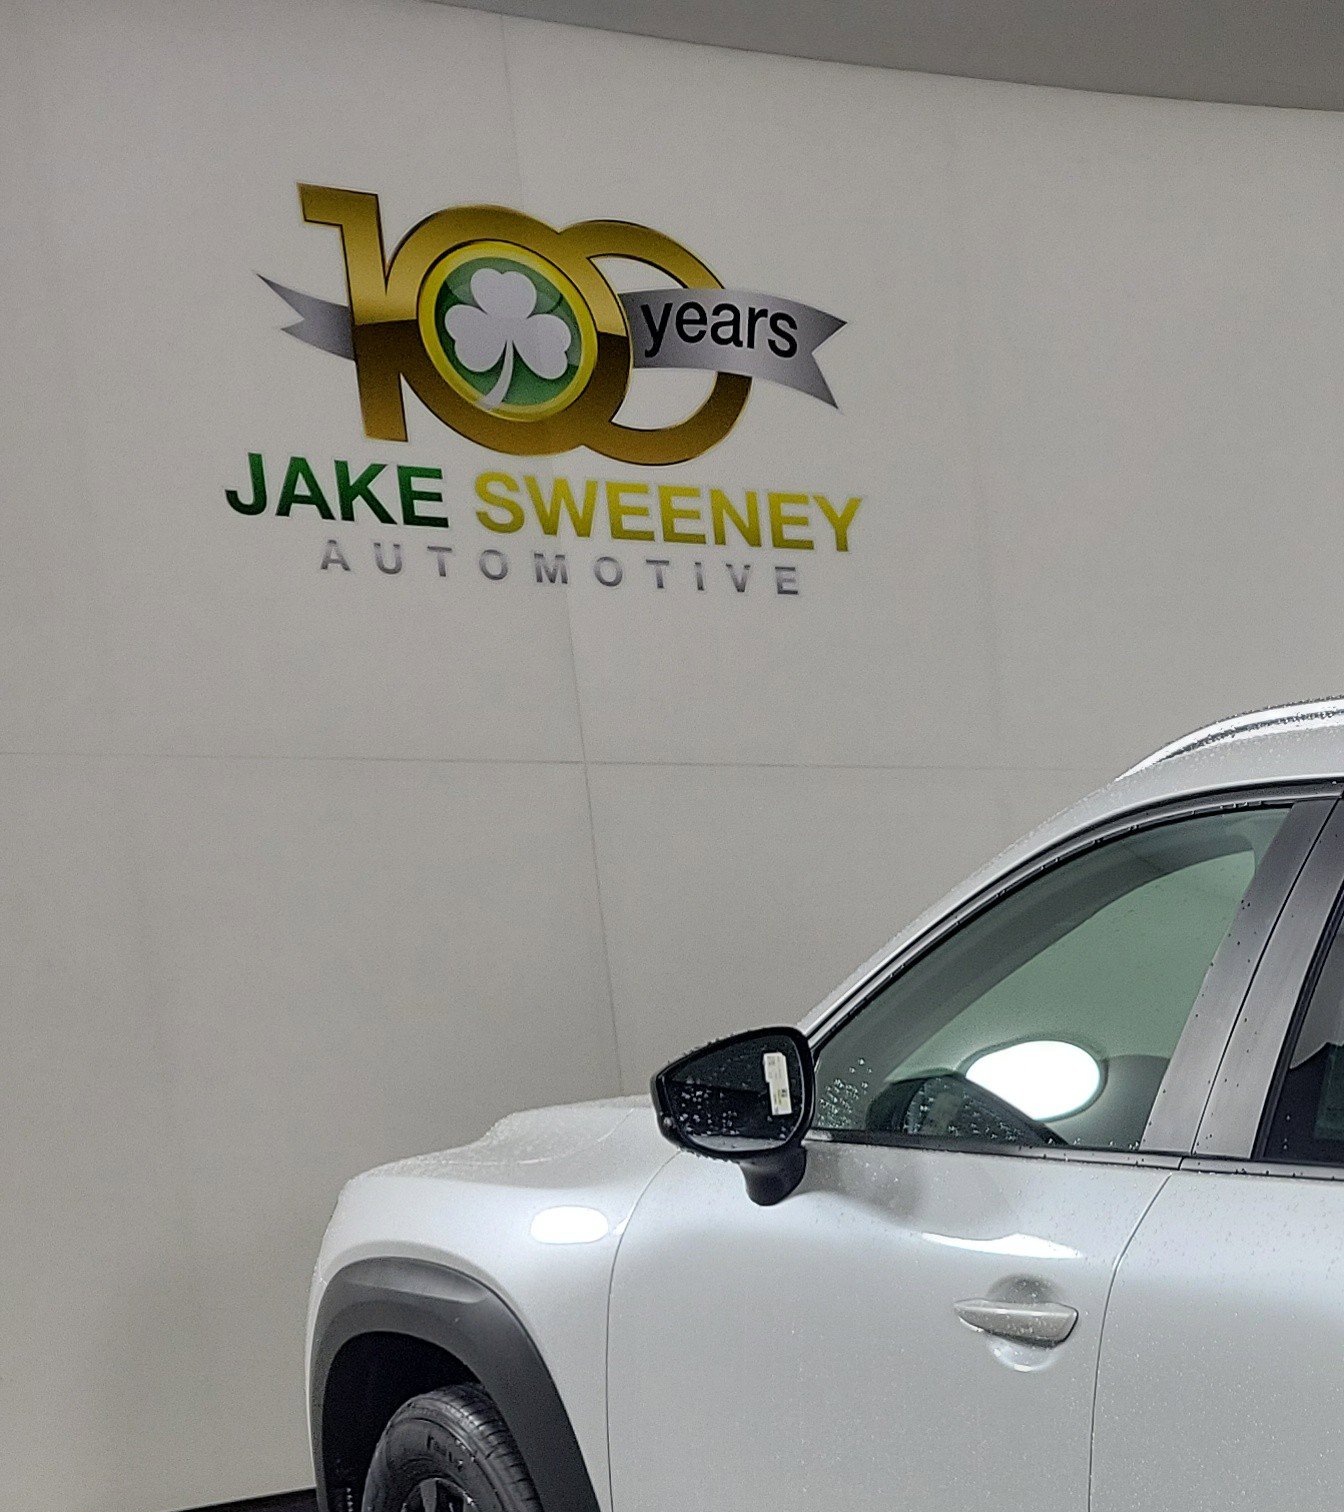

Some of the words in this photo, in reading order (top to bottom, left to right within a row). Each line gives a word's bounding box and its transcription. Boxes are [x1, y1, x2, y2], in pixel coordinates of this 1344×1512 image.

[297, 181, 753, 466] 100
[641, 299, 799, 360] years
[224, 452, 450, 528] JAKE
[473, 470, 863, 553] SWEENEY
[320, 539, 801, 596] AUTOMOTIVE
